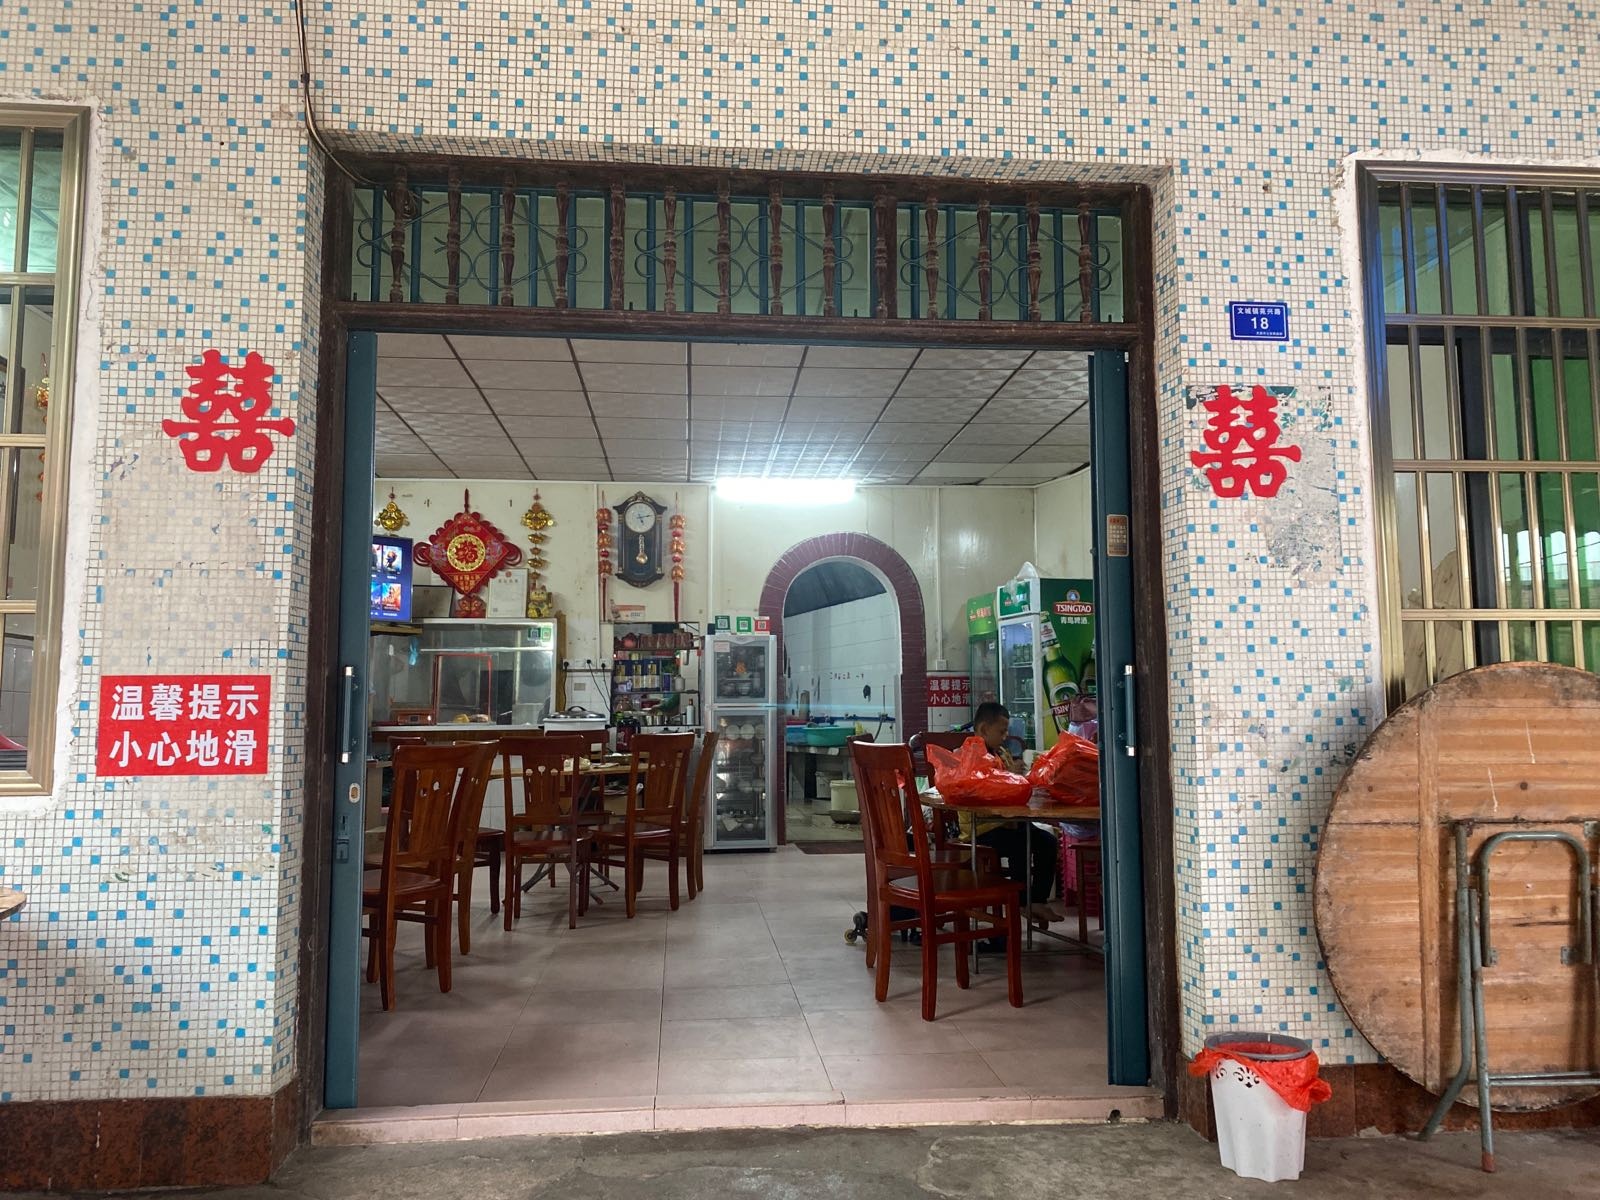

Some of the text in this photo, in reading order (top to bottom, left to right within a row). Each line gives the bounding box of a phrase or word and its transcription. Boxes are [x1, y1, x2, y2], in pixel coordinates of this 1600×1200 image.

[1251, 316, 1269, 330] 18
[1055, 604, 1092, 613] TSINGTAO
[930, 679, 971, 691] 温馨提示
[110, 684, 259, 722] 温馨提示
[109, 729, 258, 768] 小心地滑
